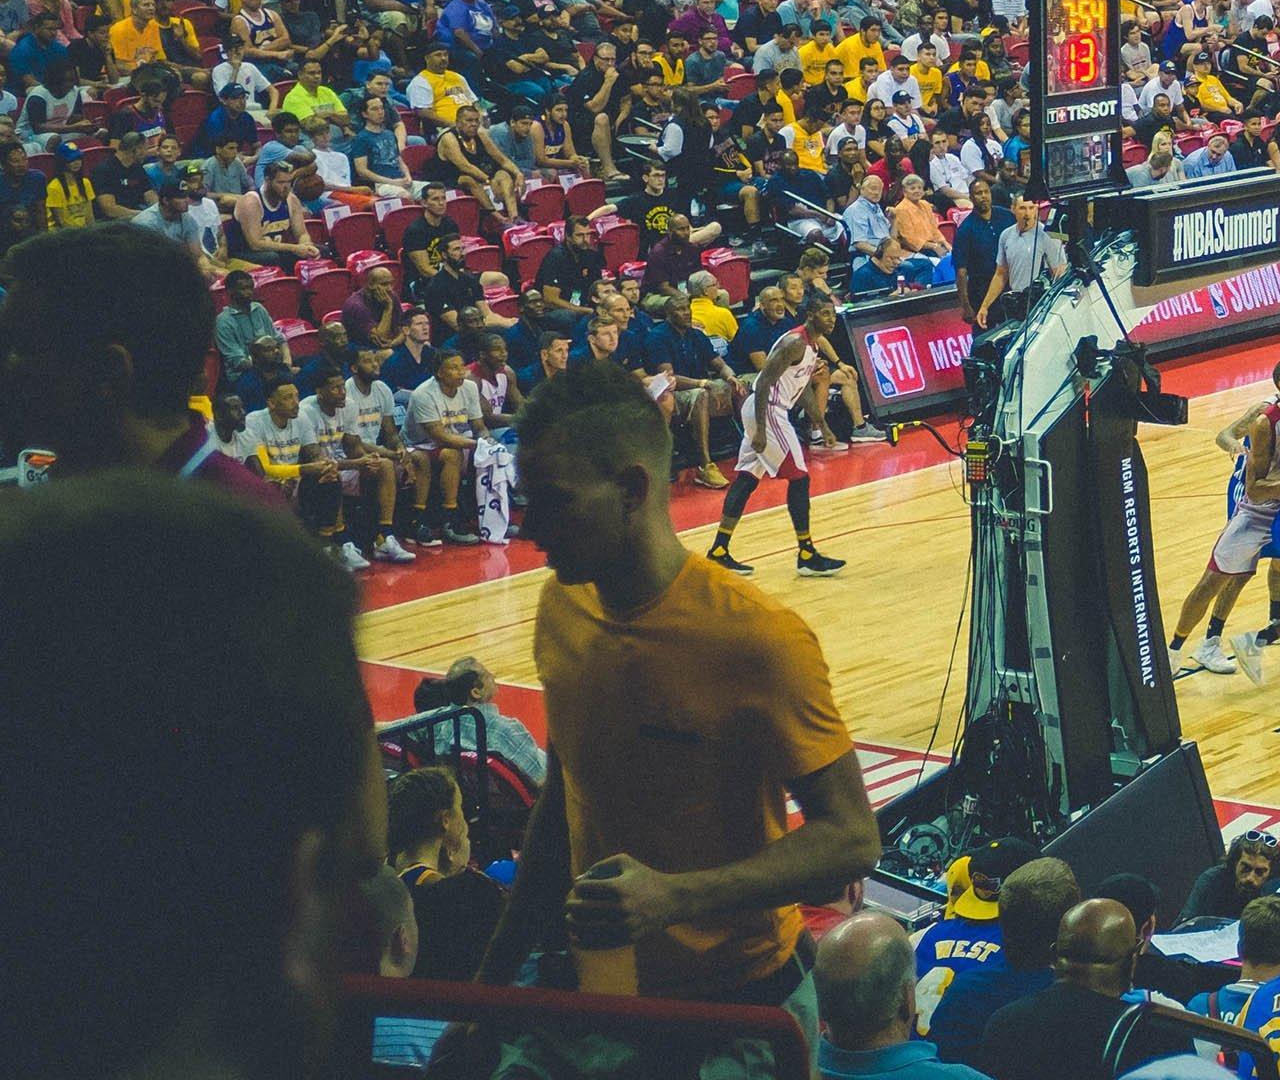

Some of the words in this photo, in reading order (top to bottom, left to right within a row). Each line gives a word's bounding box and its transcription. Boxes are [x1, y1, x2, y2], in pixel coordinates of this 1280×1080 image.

[1069, 38, 1097, 83] 13
[1068, 100, 1118, 122] TISSOT
[1172, 206, 1280, 263] #NBASummer
[887, 339, 916, 381] TV
[928, 333, 974, 371] MGM
[1121, 457, 1134, 495] MGM
[1124, 498, 1141, 566] RESORTS
[1131, 568, 1152, 687] INTERNATIONAL
[934, 938, 1001, 962] WEST
